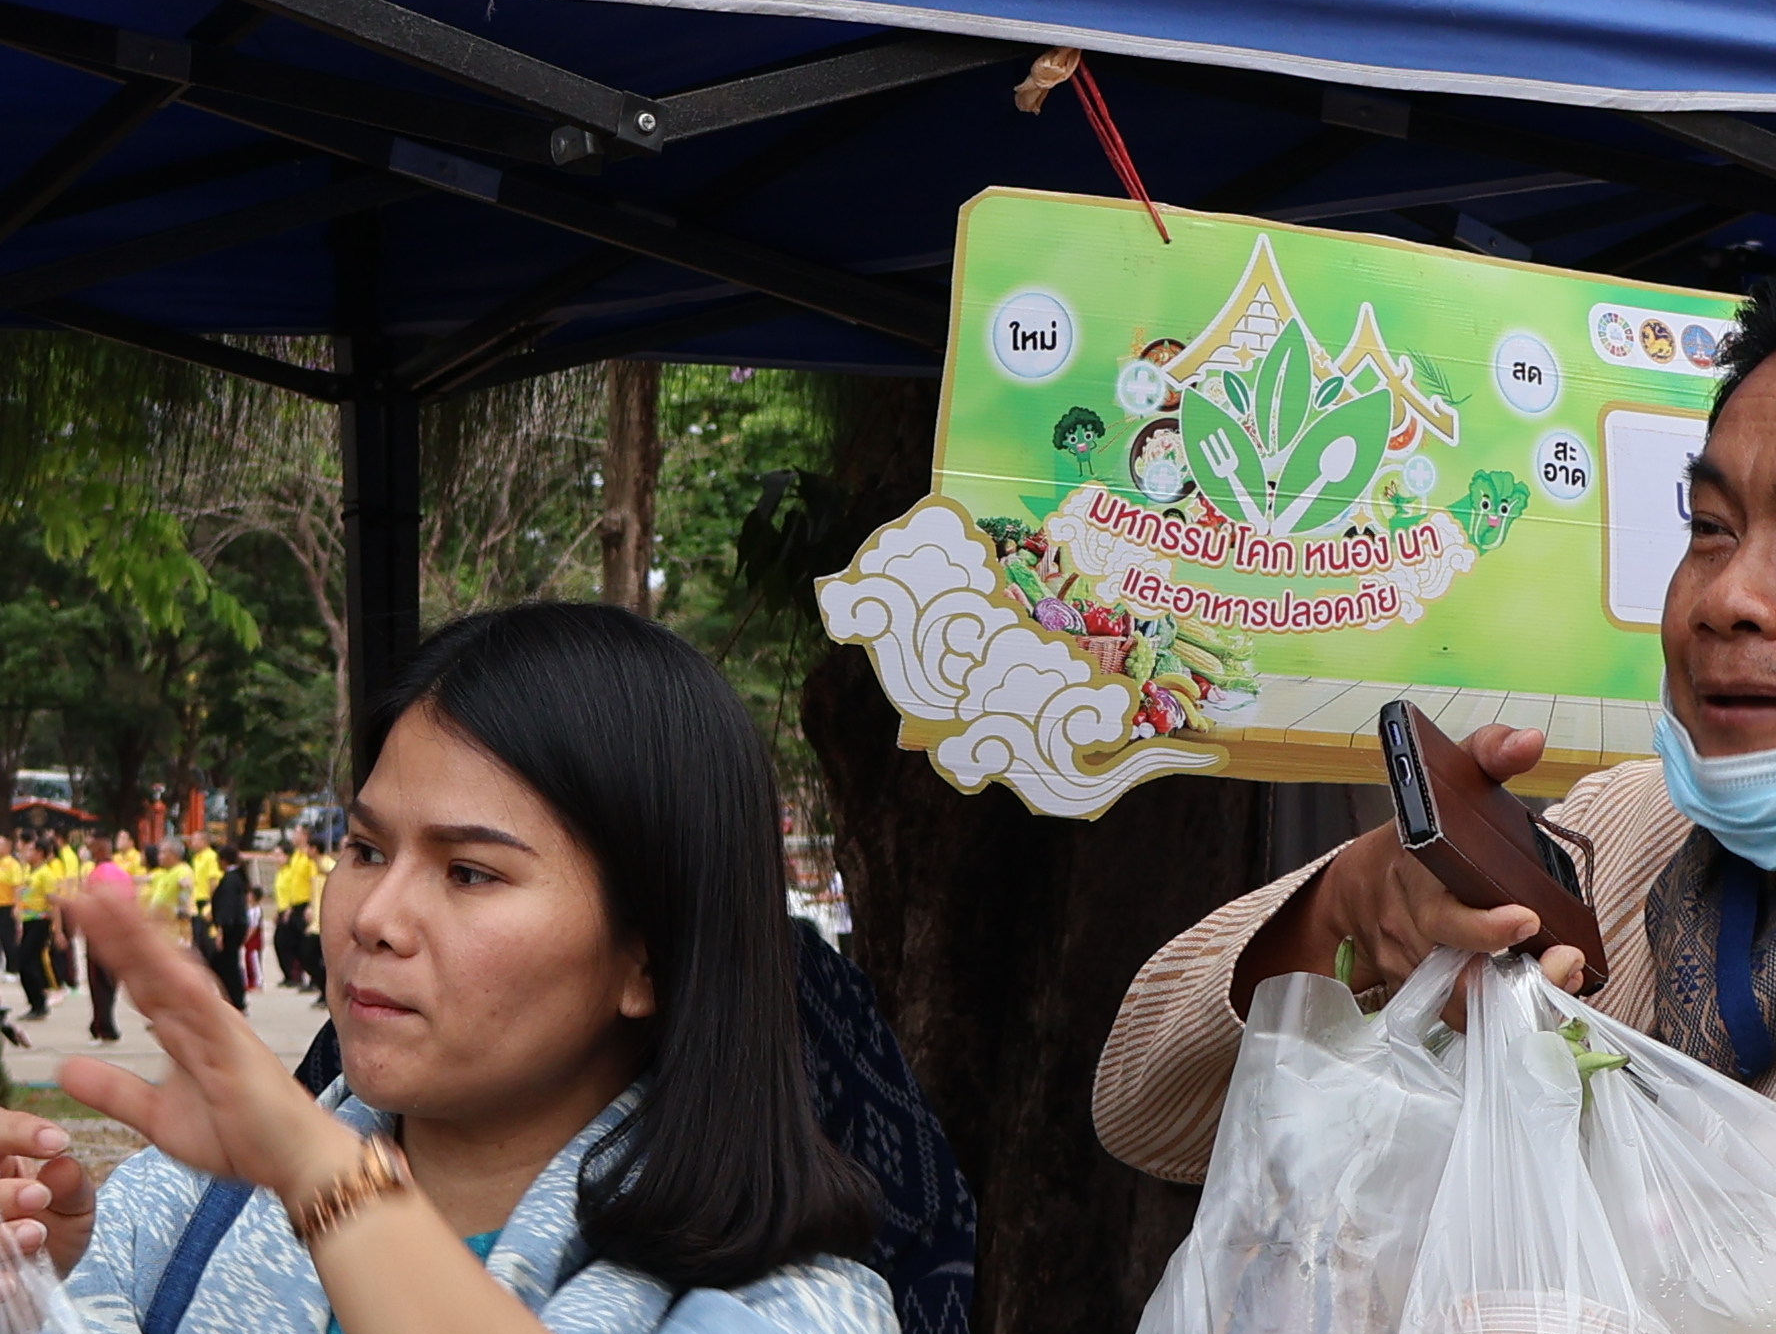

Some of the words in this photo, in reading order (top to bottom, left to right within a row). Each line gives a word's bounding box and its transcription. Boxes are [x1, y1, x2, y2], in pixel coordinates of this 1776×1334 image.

[1009, 320, 1058, 351] ใหม่
[1512, 362, 1542, 385] สด
[1554, 441, 1577, 461] สะ
[1543, 462, 1586, 488] อาด
[1089, 492, 1226, 560] มหกรรม
[1234, 527, 1291, 573] โคก
[1305, 535, 1390, 571] หนอง
[1397, 523, 1439, 560] นา
[1121, 568, 1399, 628] และอาหารปลอดภัย
